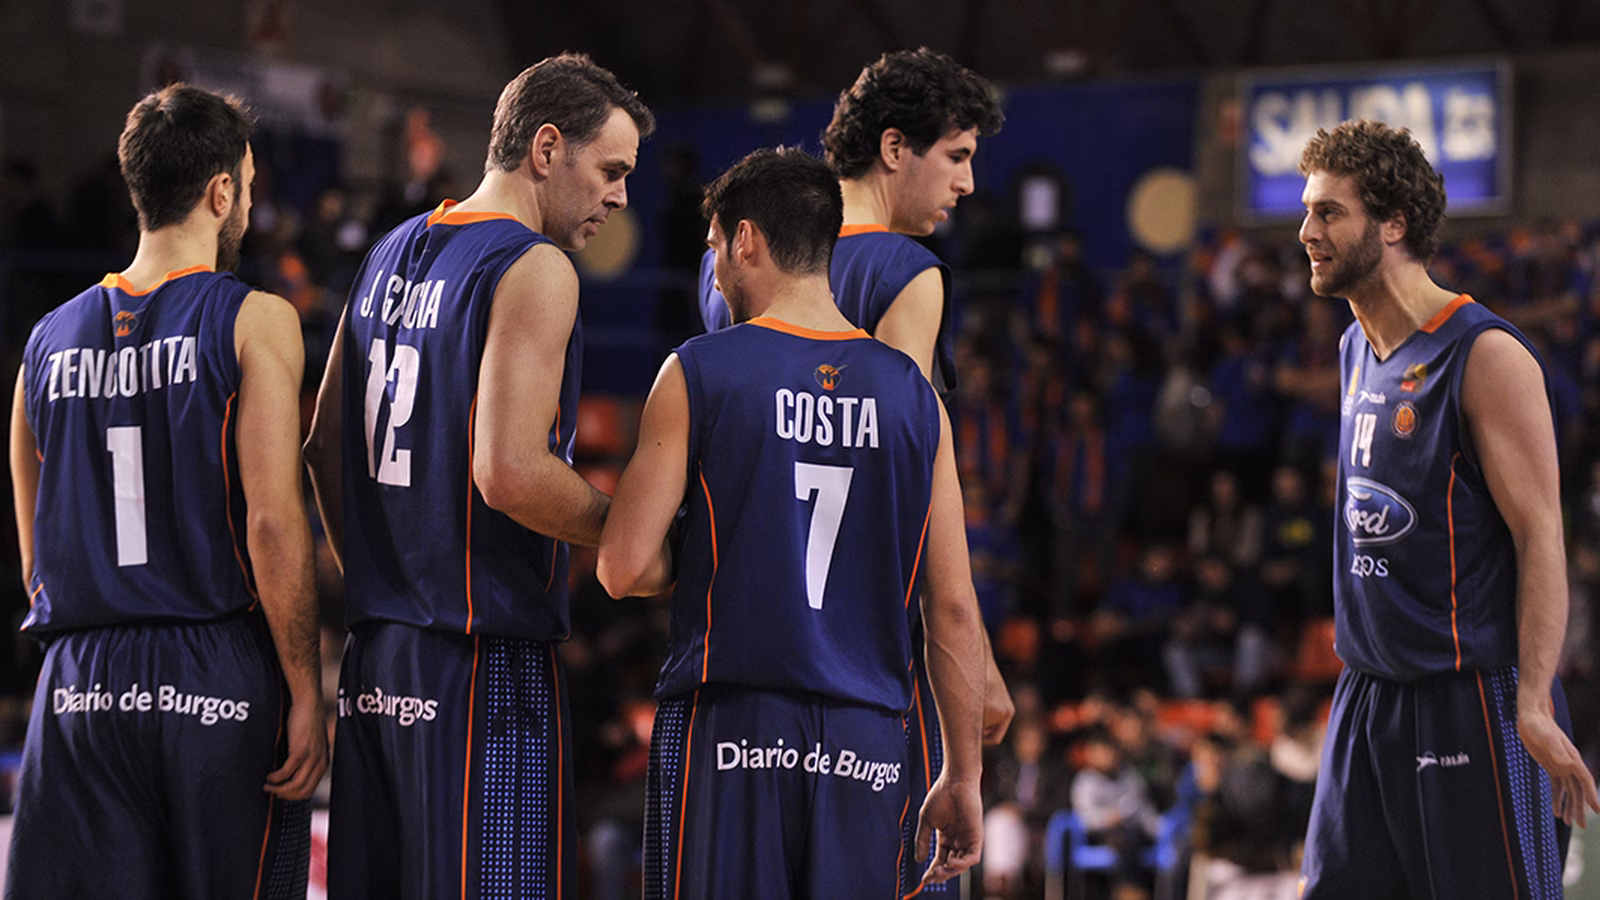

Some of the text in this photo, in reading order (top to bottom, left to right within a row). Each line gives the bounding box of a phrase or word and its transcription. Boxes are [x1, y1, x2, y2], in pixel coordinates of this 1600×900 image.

[360, 270, 384, 318] J.
[364, 338, 420, 487] 12
[775, 388, 879, 449] COSTA
[106, 426, 148, 567] 1
[794, 461, 854, 610] 7
[53, 683, 250, 725] Diario de Burgos
[716, 738, 902, 792] Diario de Burgos
